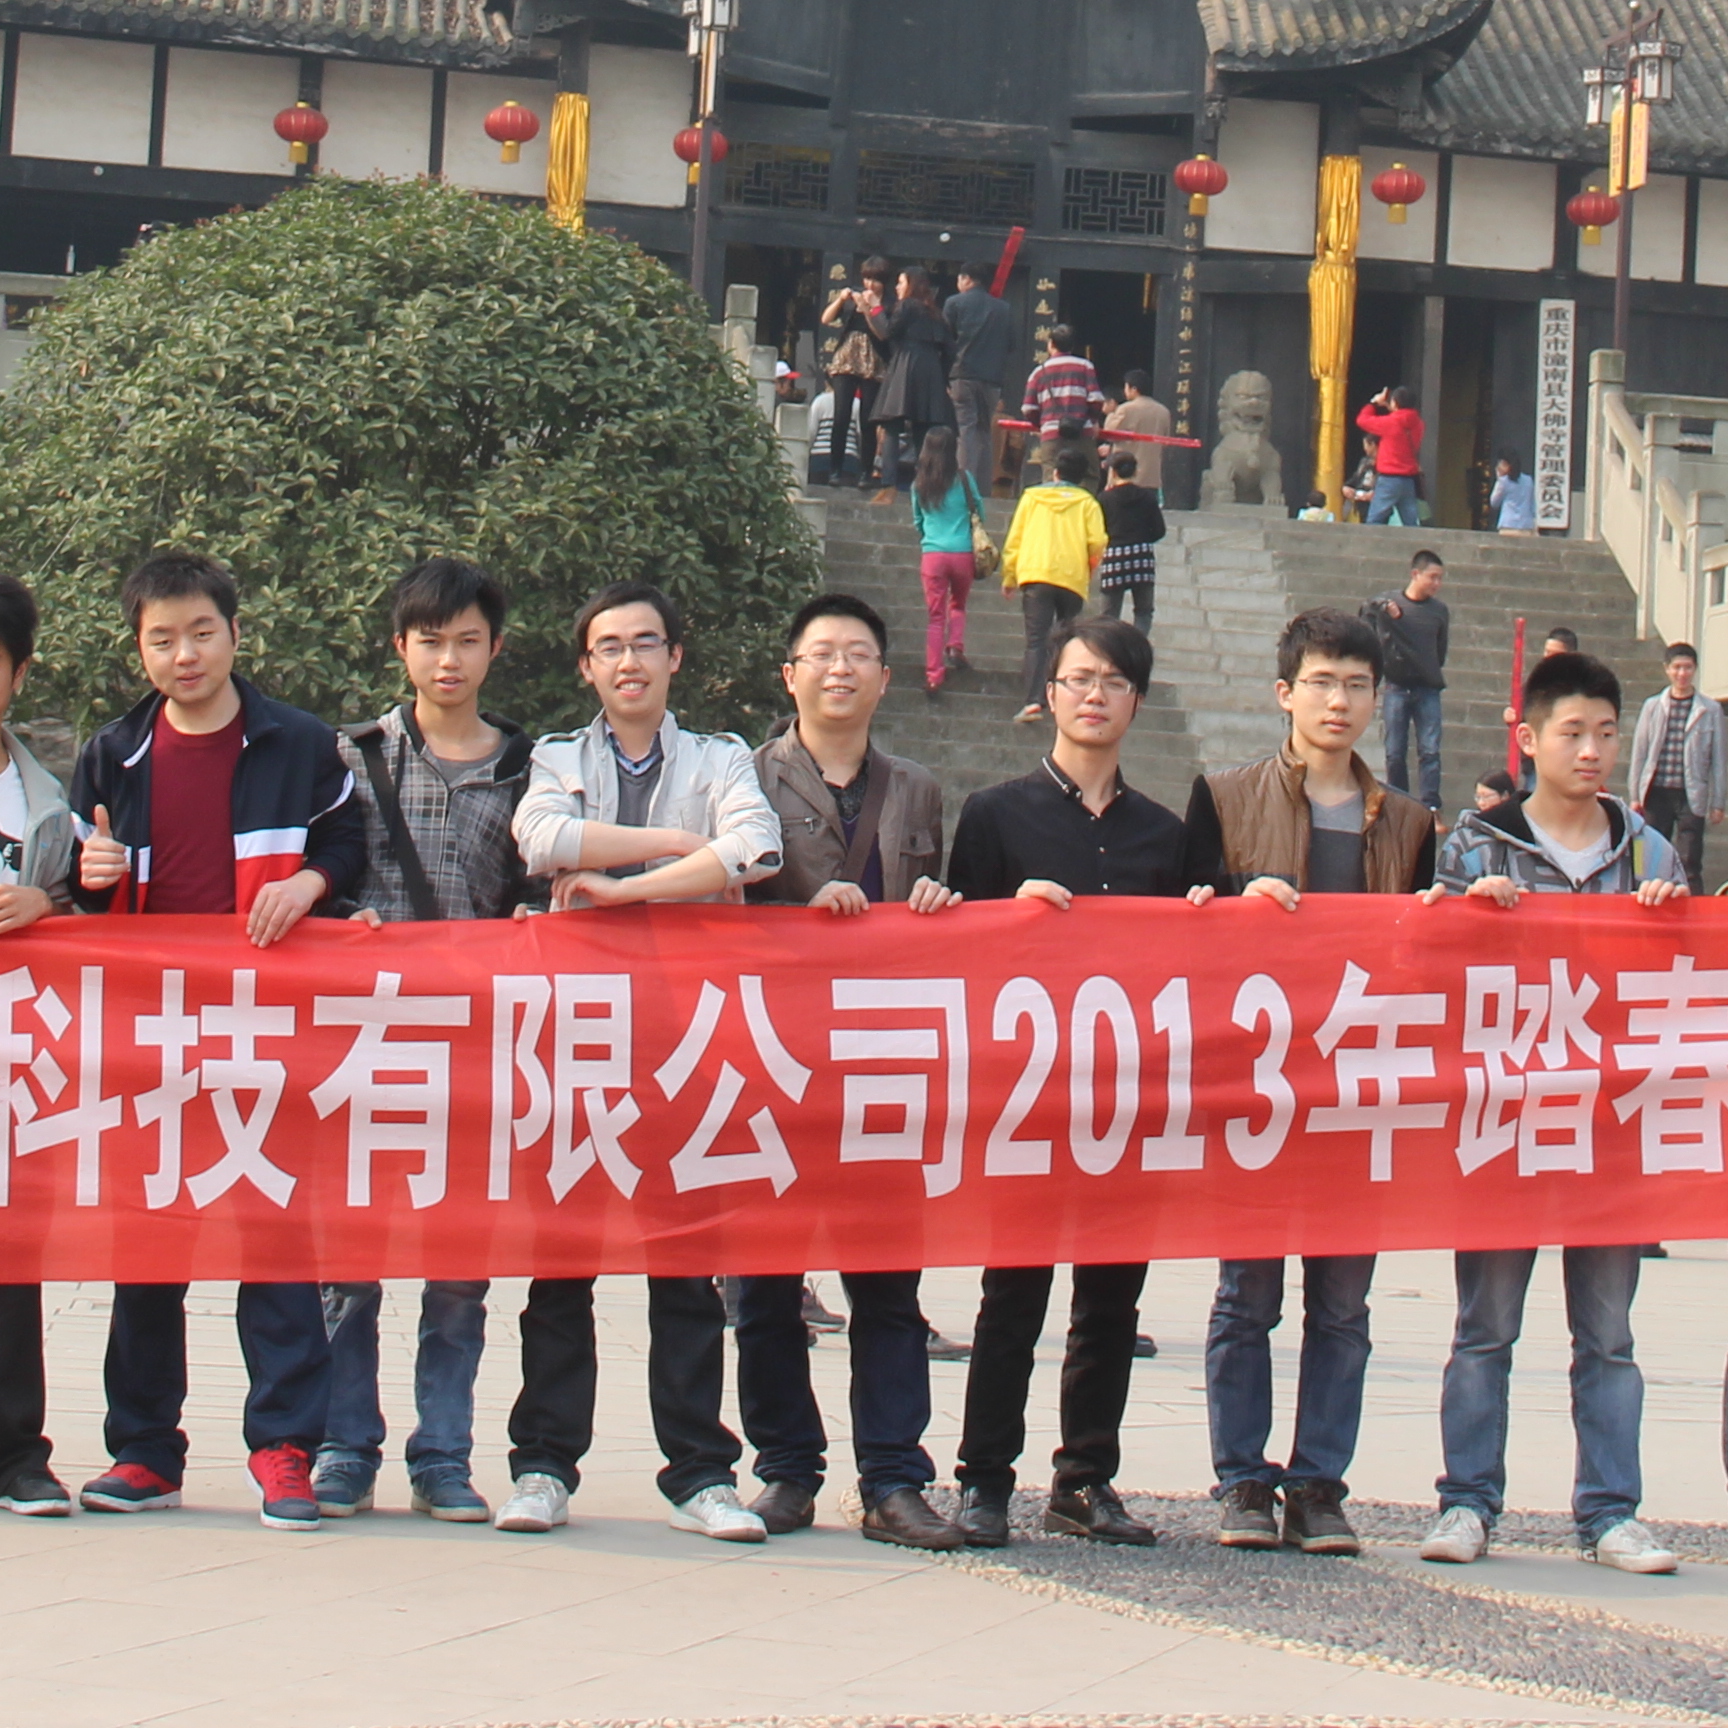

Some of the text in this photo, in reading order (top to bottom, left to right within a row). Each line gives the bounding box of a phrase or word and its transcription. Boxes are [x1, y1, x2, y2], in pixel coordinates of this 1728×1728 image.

[1538, 307, 1571, 519] 重庆市潼南县大佛寺管理委员会
